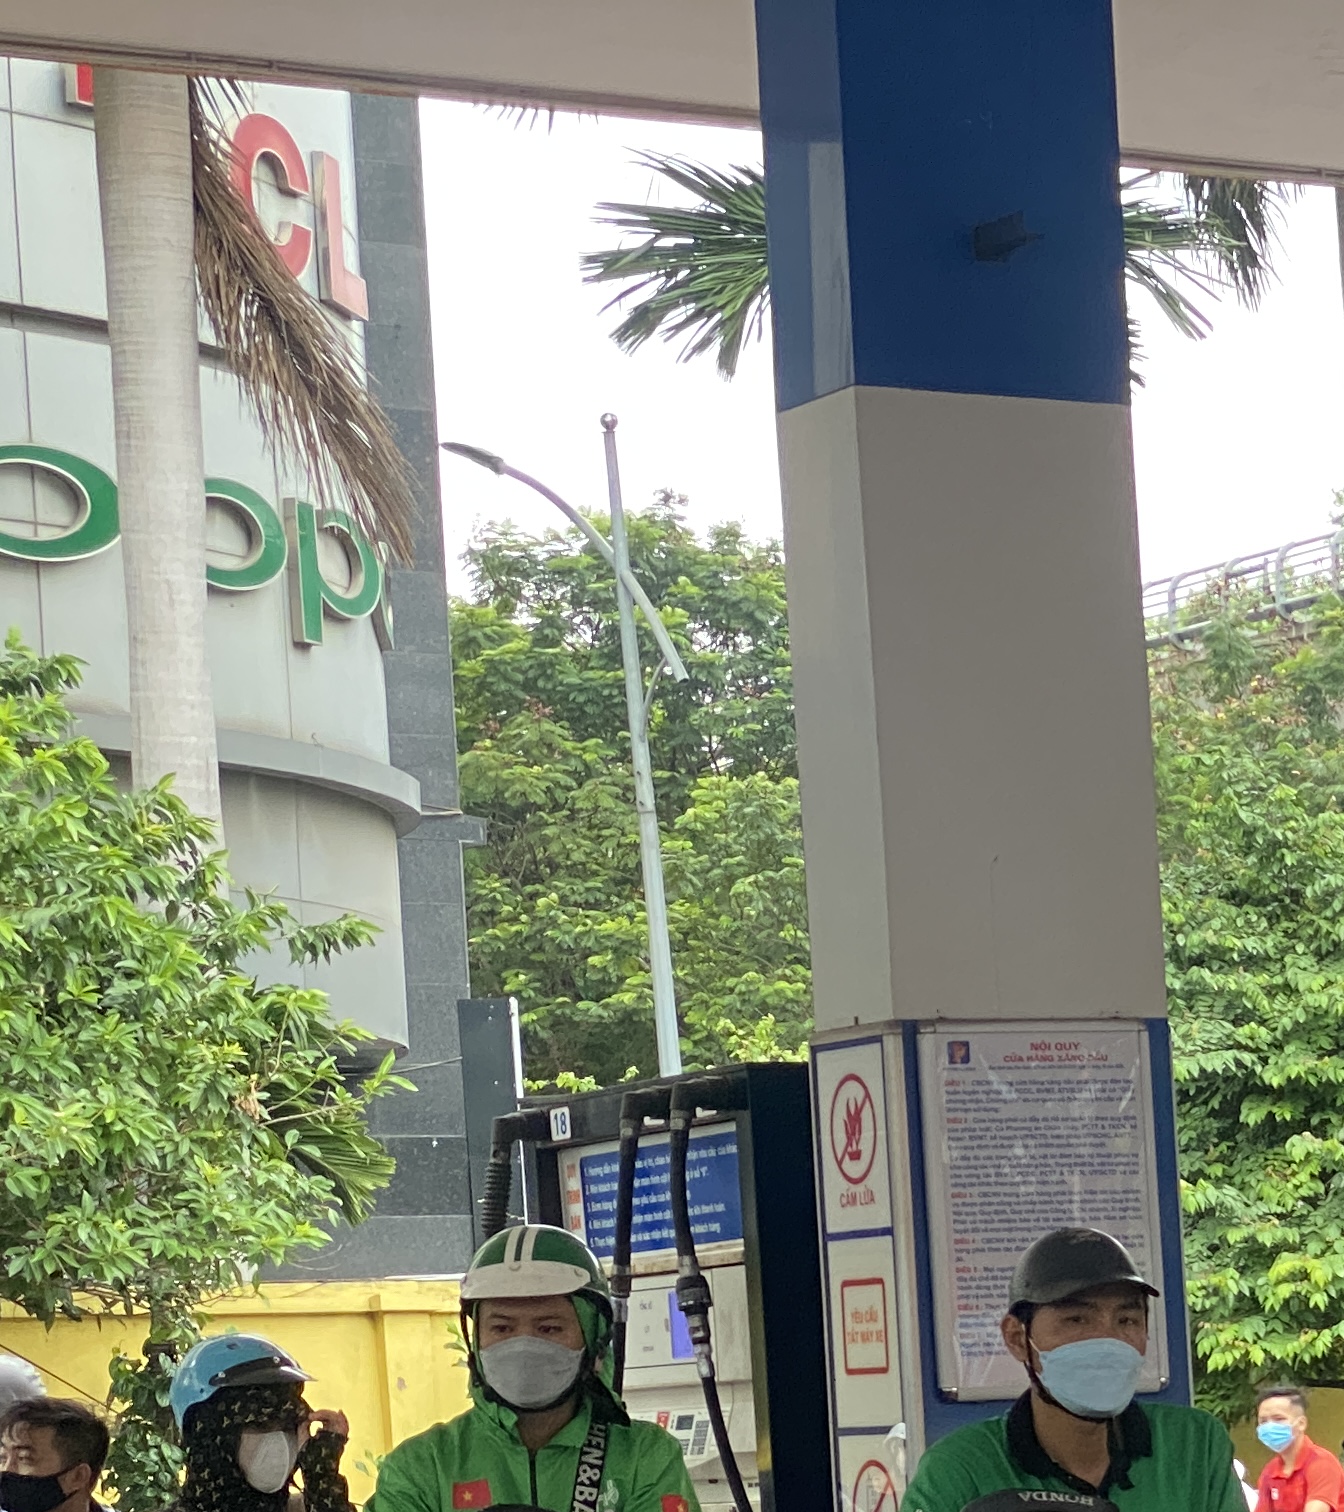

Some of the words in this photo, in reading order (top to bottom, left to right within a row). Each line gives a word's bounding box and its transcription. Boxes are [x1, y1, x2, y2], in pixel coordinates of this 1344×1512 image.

[1030, 1042, 1051, 1053] NỘI
[1055, 1042, 1080, 1051] QUY
[1003, 1053, 1024, 1063] CỬA
[1027, 1053, 1053, 1063] HÀNG
[1057, 1052, 1083, 1062] XĂNG
[554, 1112, 567, 1136] 18
[840, 1188, 857, 1208] CẤM
[859, 1185, 875, 1206] LỬA
[1018, 1491, 1094, 1506] HONDA
